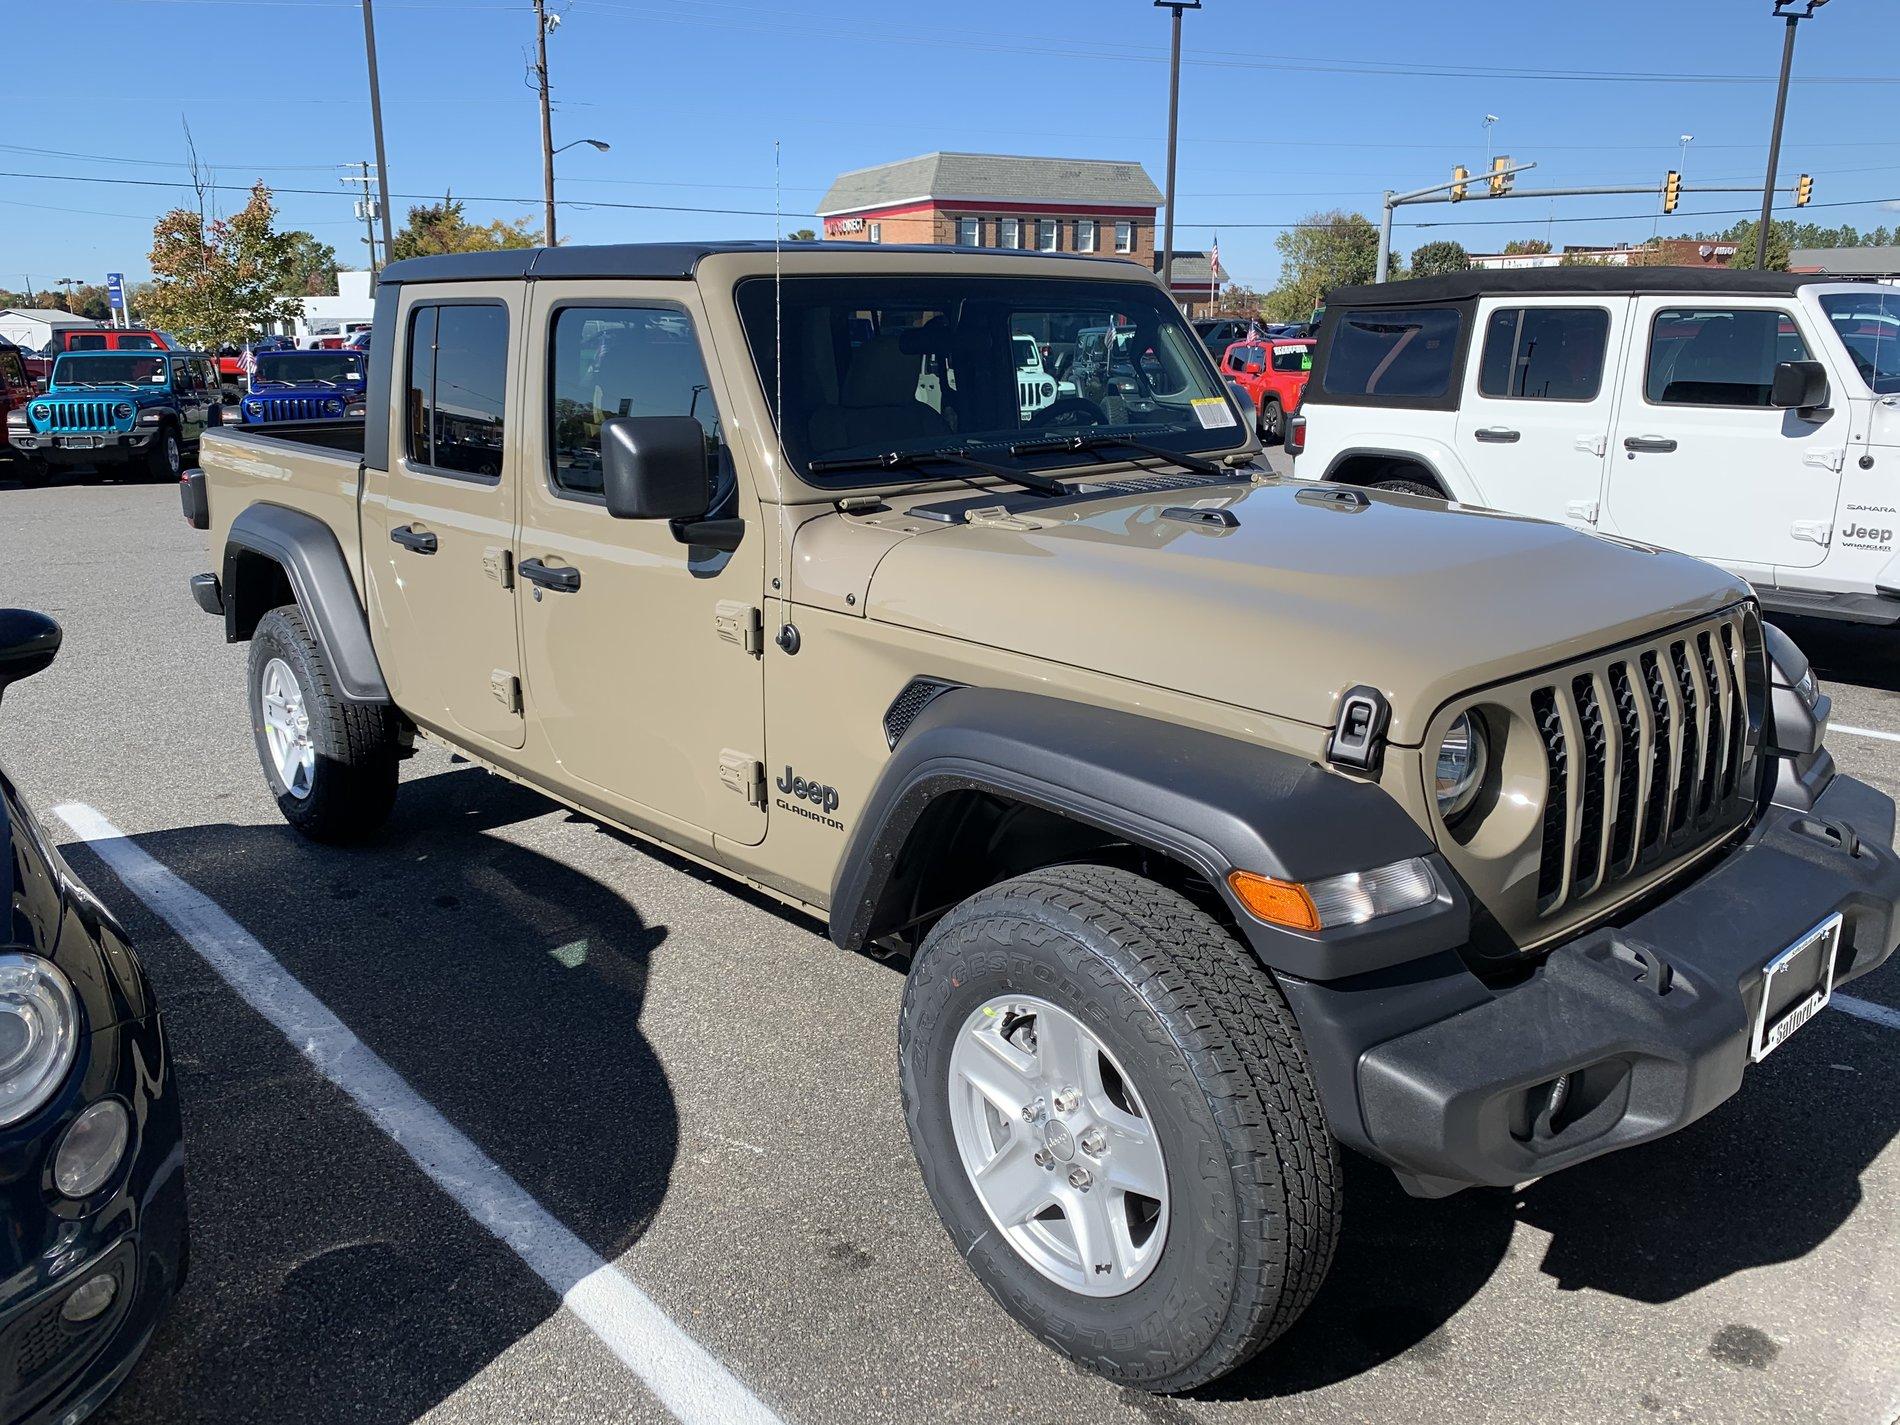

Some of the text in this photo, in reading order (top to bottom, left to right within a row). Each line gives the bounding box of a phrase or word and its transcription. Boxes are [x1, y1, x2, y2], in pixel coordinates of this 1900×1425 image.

[1846, 504, 1896, 513] SAHARA
[1842, 523, 1893, 543] Jeep
[1842, 542, 1891, 551] WRANGLER
[776, 764, 839, 814] Jeep
[776, 798, 844, 832] GLADIATOR
[1776, 999, 1813, 1045] Safford
